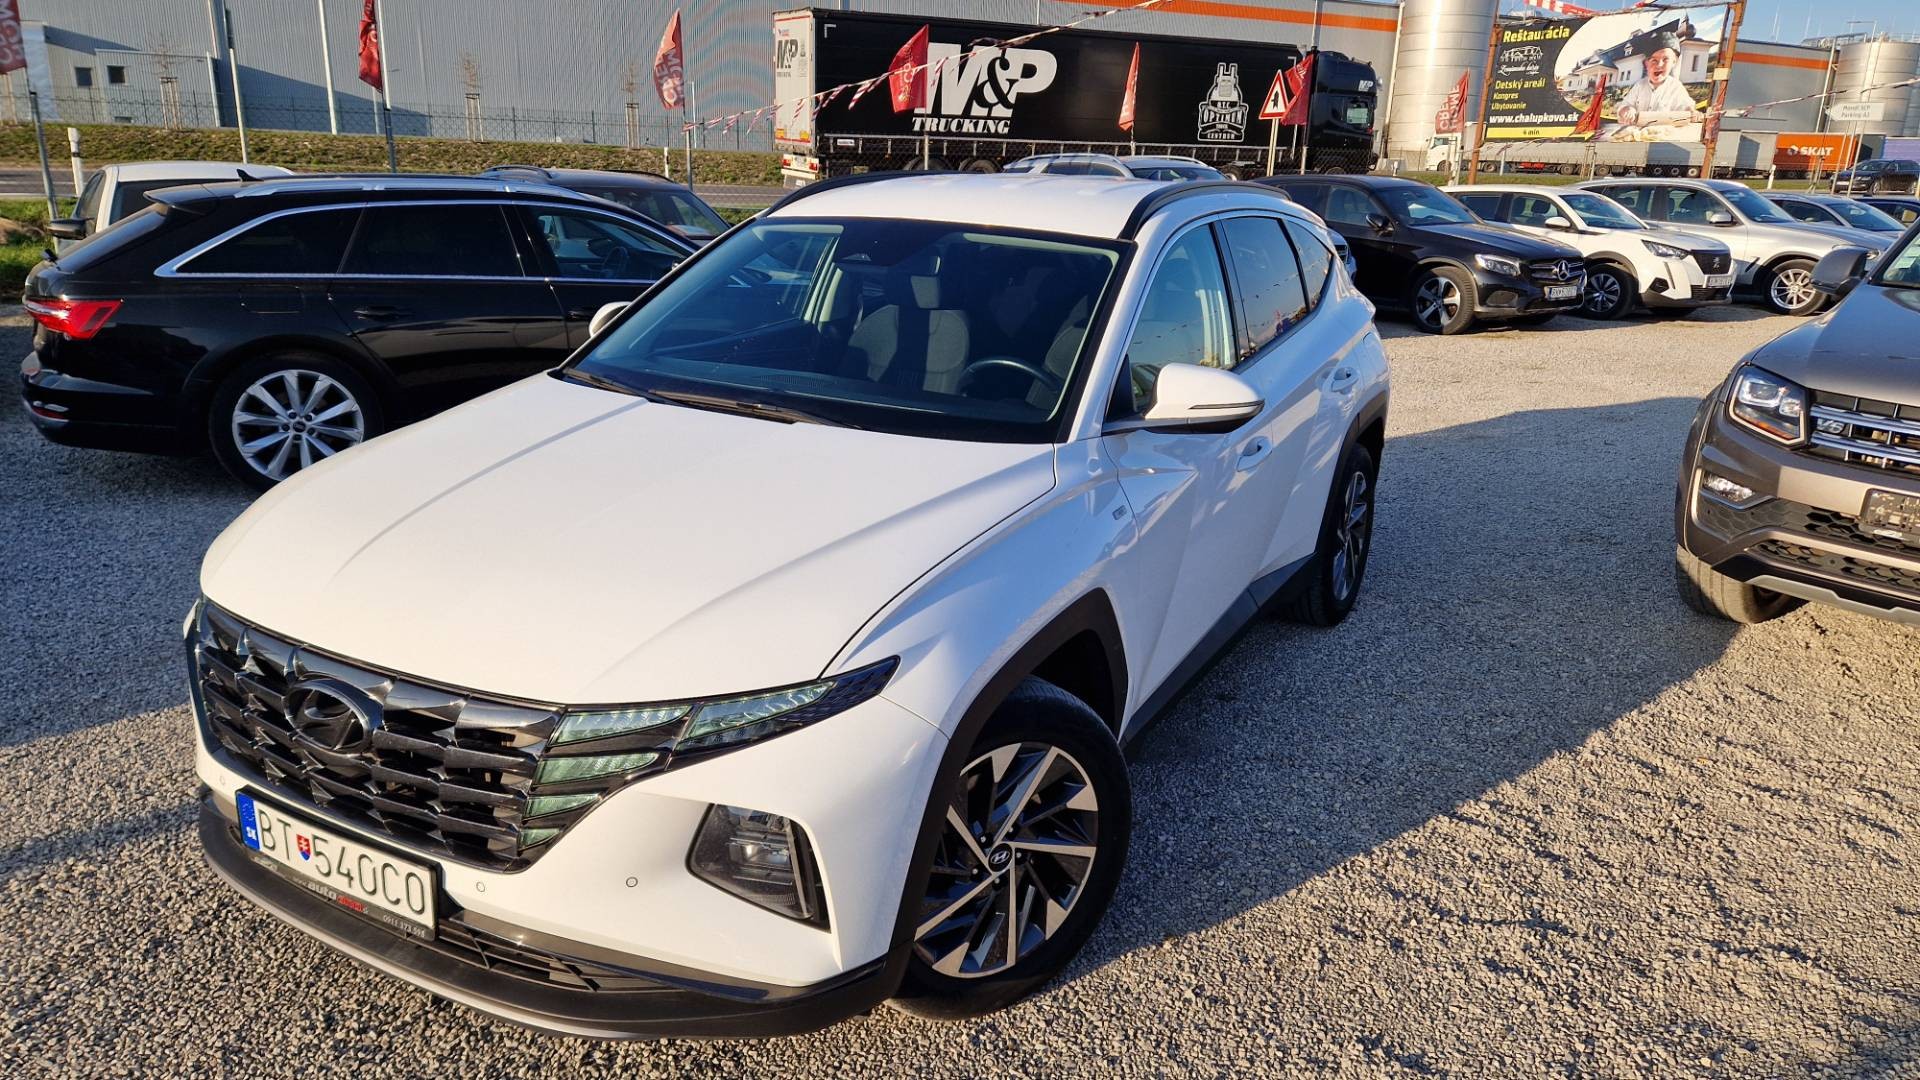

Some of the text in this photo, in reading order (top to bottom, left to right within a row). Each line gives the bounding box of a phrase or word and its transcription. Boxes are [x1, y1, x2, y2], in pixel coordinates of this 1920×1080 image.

[1503, 26, 1570, 42] Reštaurácia
[914, 42, 1058, 118] M&P
[1495, 77, 1546, 91] Detský areál
[1491, 102, 1527, 112] Ubytovanie
[912, 117, 1011, 134] TRUCKING
[1490, 112, 1579, 125] www.chalupkovo.sk
[1800, 147, 1834, 156] SKAT
[1817, 418, 1845, 434] V6
[258, 808, 425, 916] BT 540CO
